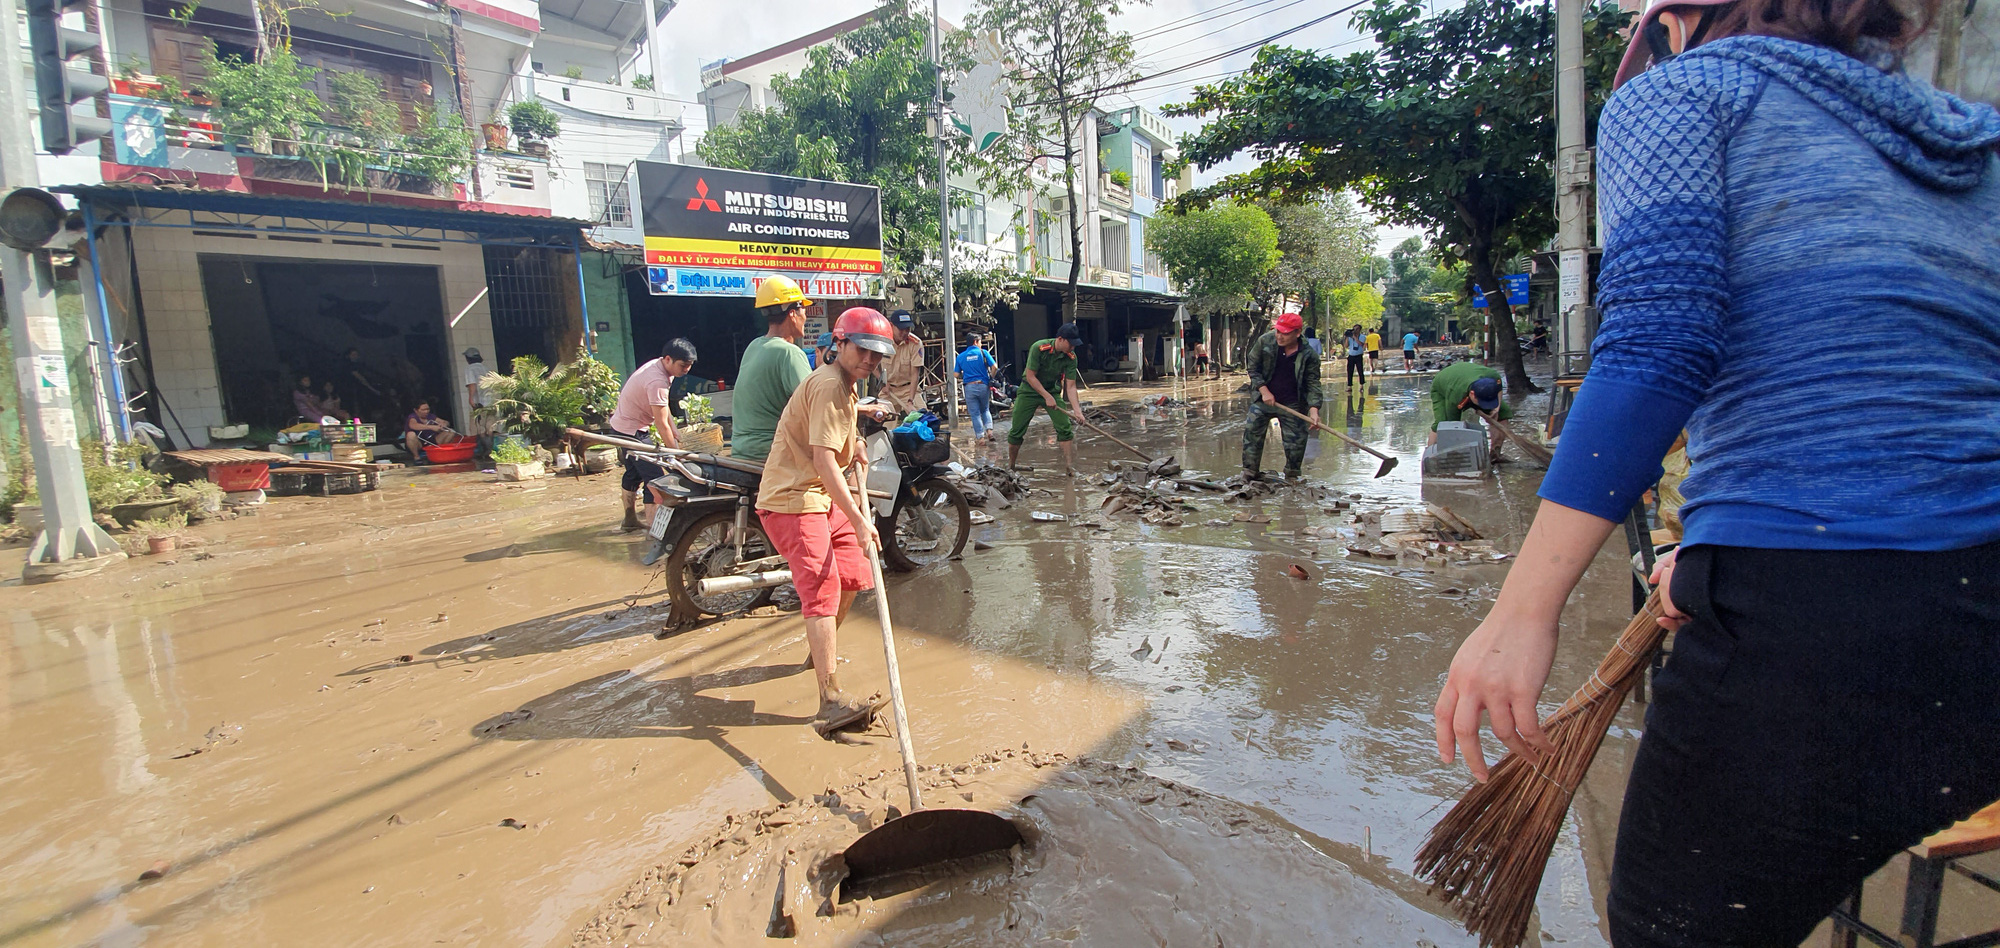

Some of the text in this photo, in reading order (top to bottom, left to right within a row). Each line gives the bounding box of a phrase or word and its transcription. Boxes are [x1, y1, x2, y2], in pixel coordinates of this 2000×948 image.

[725, 190, 847, 215] MITSUBISHI
[725, 205, 849, 223] HEAVY INDUSTRIES, LTD.
[727, 222, 850, 240] AIR CONDITIONERS
[739, 244, 813, 256] HEAVY DUTY
[658, 255, 677, 265] ĐẠI
[680, 254, 693, 264] LÝ
[747, 258, 794, 268] MISUBISHI
[796, 261, 823, 269] HEAVY
[825, 262, 839, 271] TẠI
[681, 273, 711, 290] ĐIỆN
[713, 276, 746, 291] LẠNH
[815, 277, 862, 298] THIỆN
